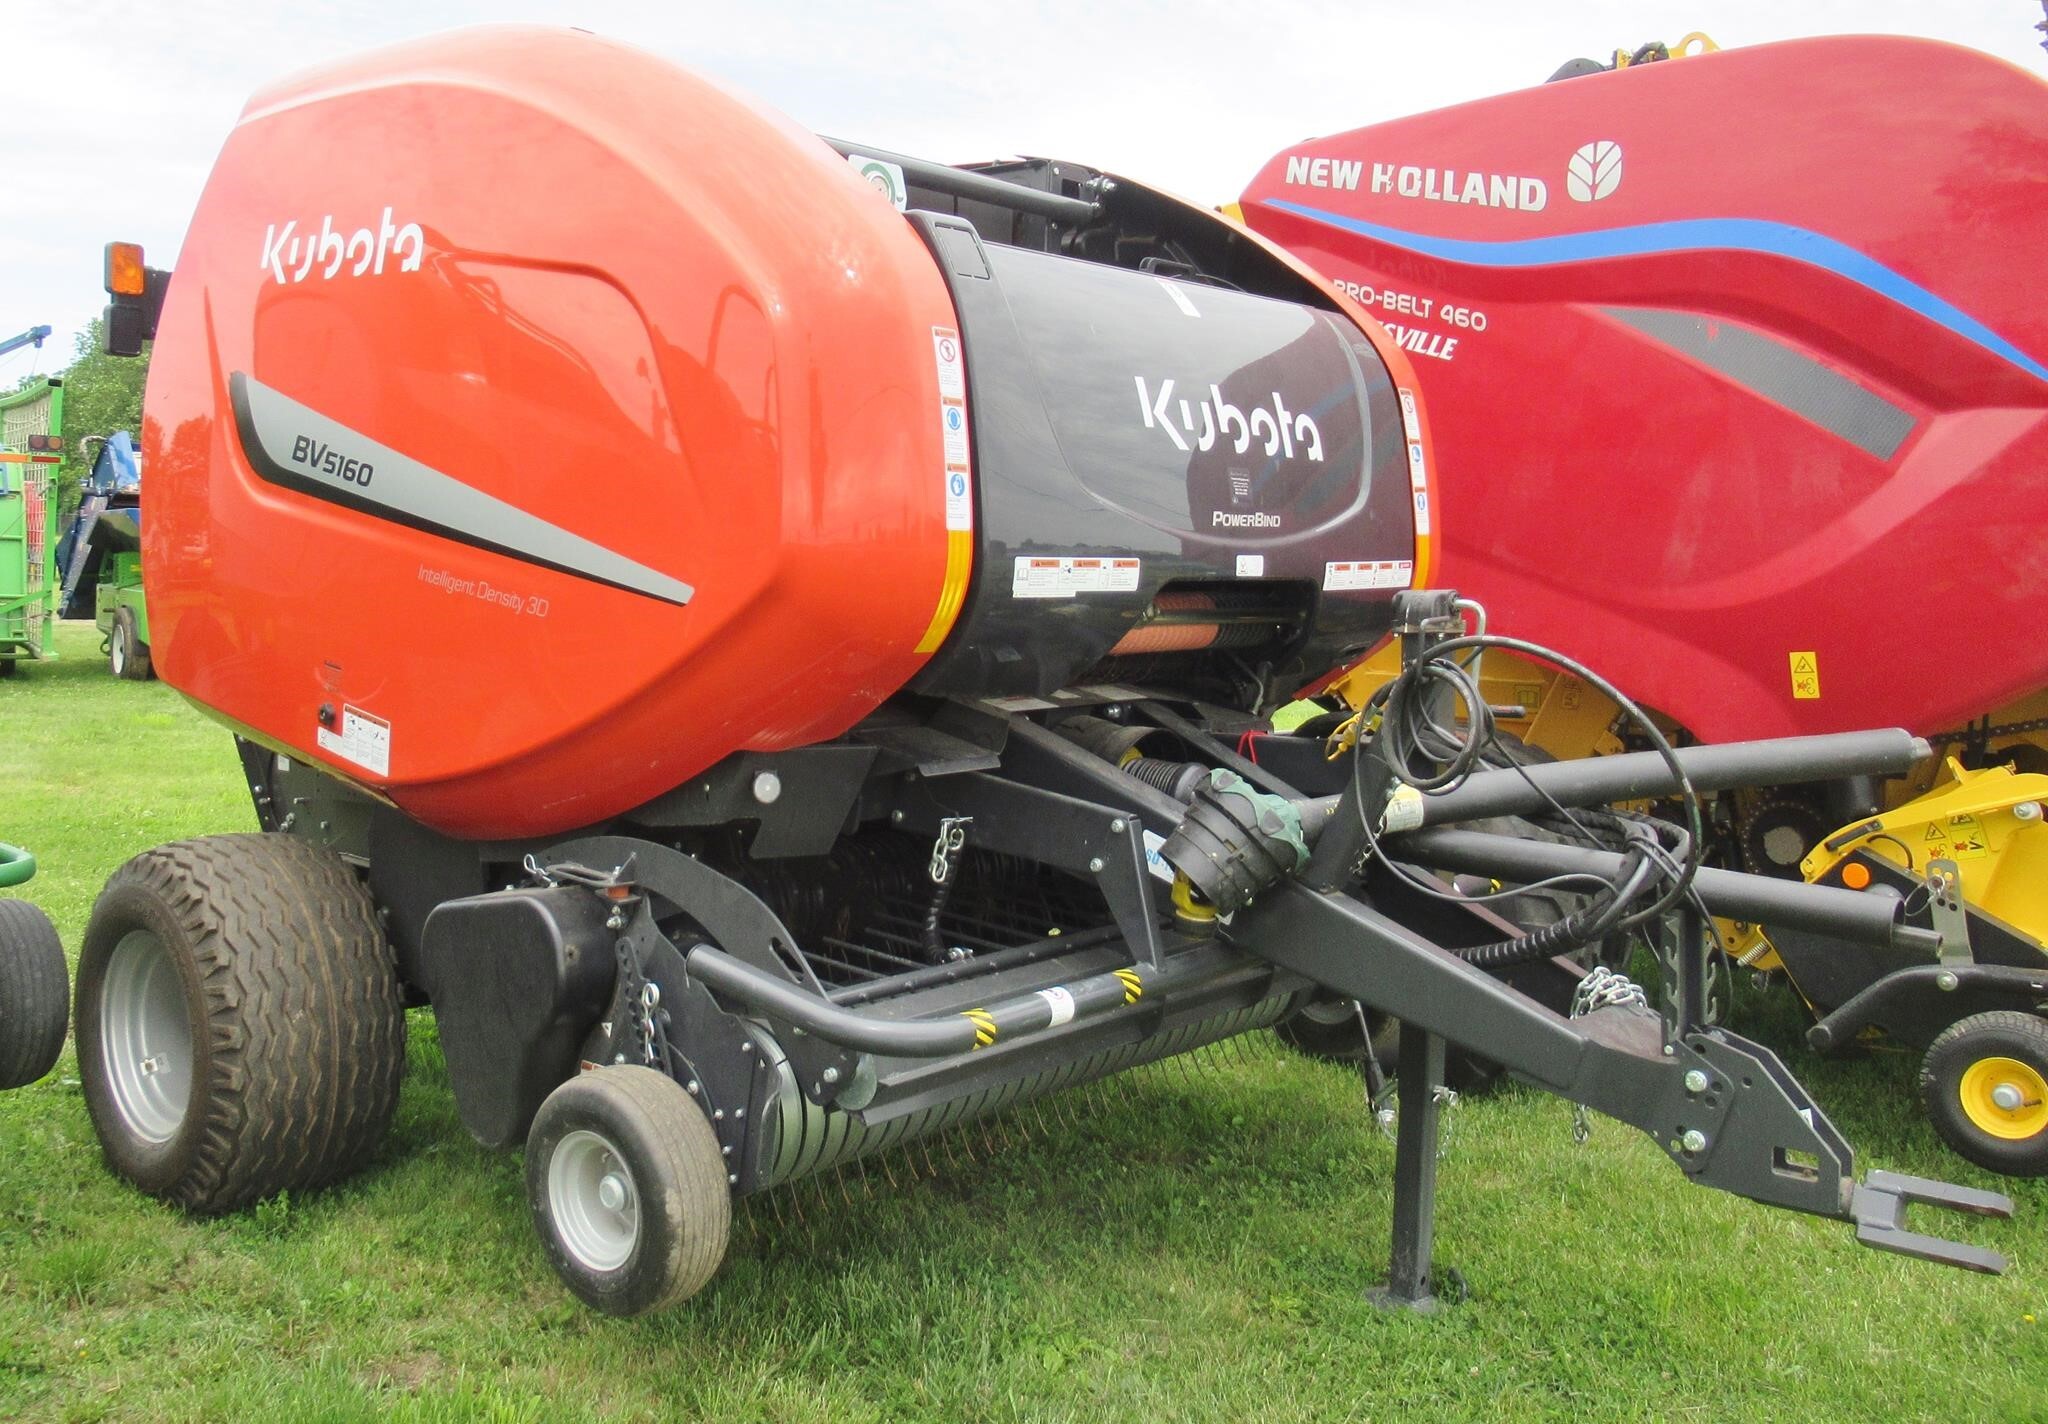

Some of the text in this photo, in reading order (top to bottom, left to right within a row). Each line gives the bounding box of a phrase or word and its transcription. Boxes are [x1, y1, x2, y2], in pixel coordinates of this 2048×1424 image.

[1285, 156, 1548, 212] NEW HOLLAND
[260, 206, 424, 285] Kubota
[1377, 320, 1458, 361] SVILLE
[1440, 304, 1487, 332] 460
[1134, 375, 1324, 462] Kubota
[291, 434, 374, 488] BV5160
[417, 563, 550, 618] Intelligent Density 3D
